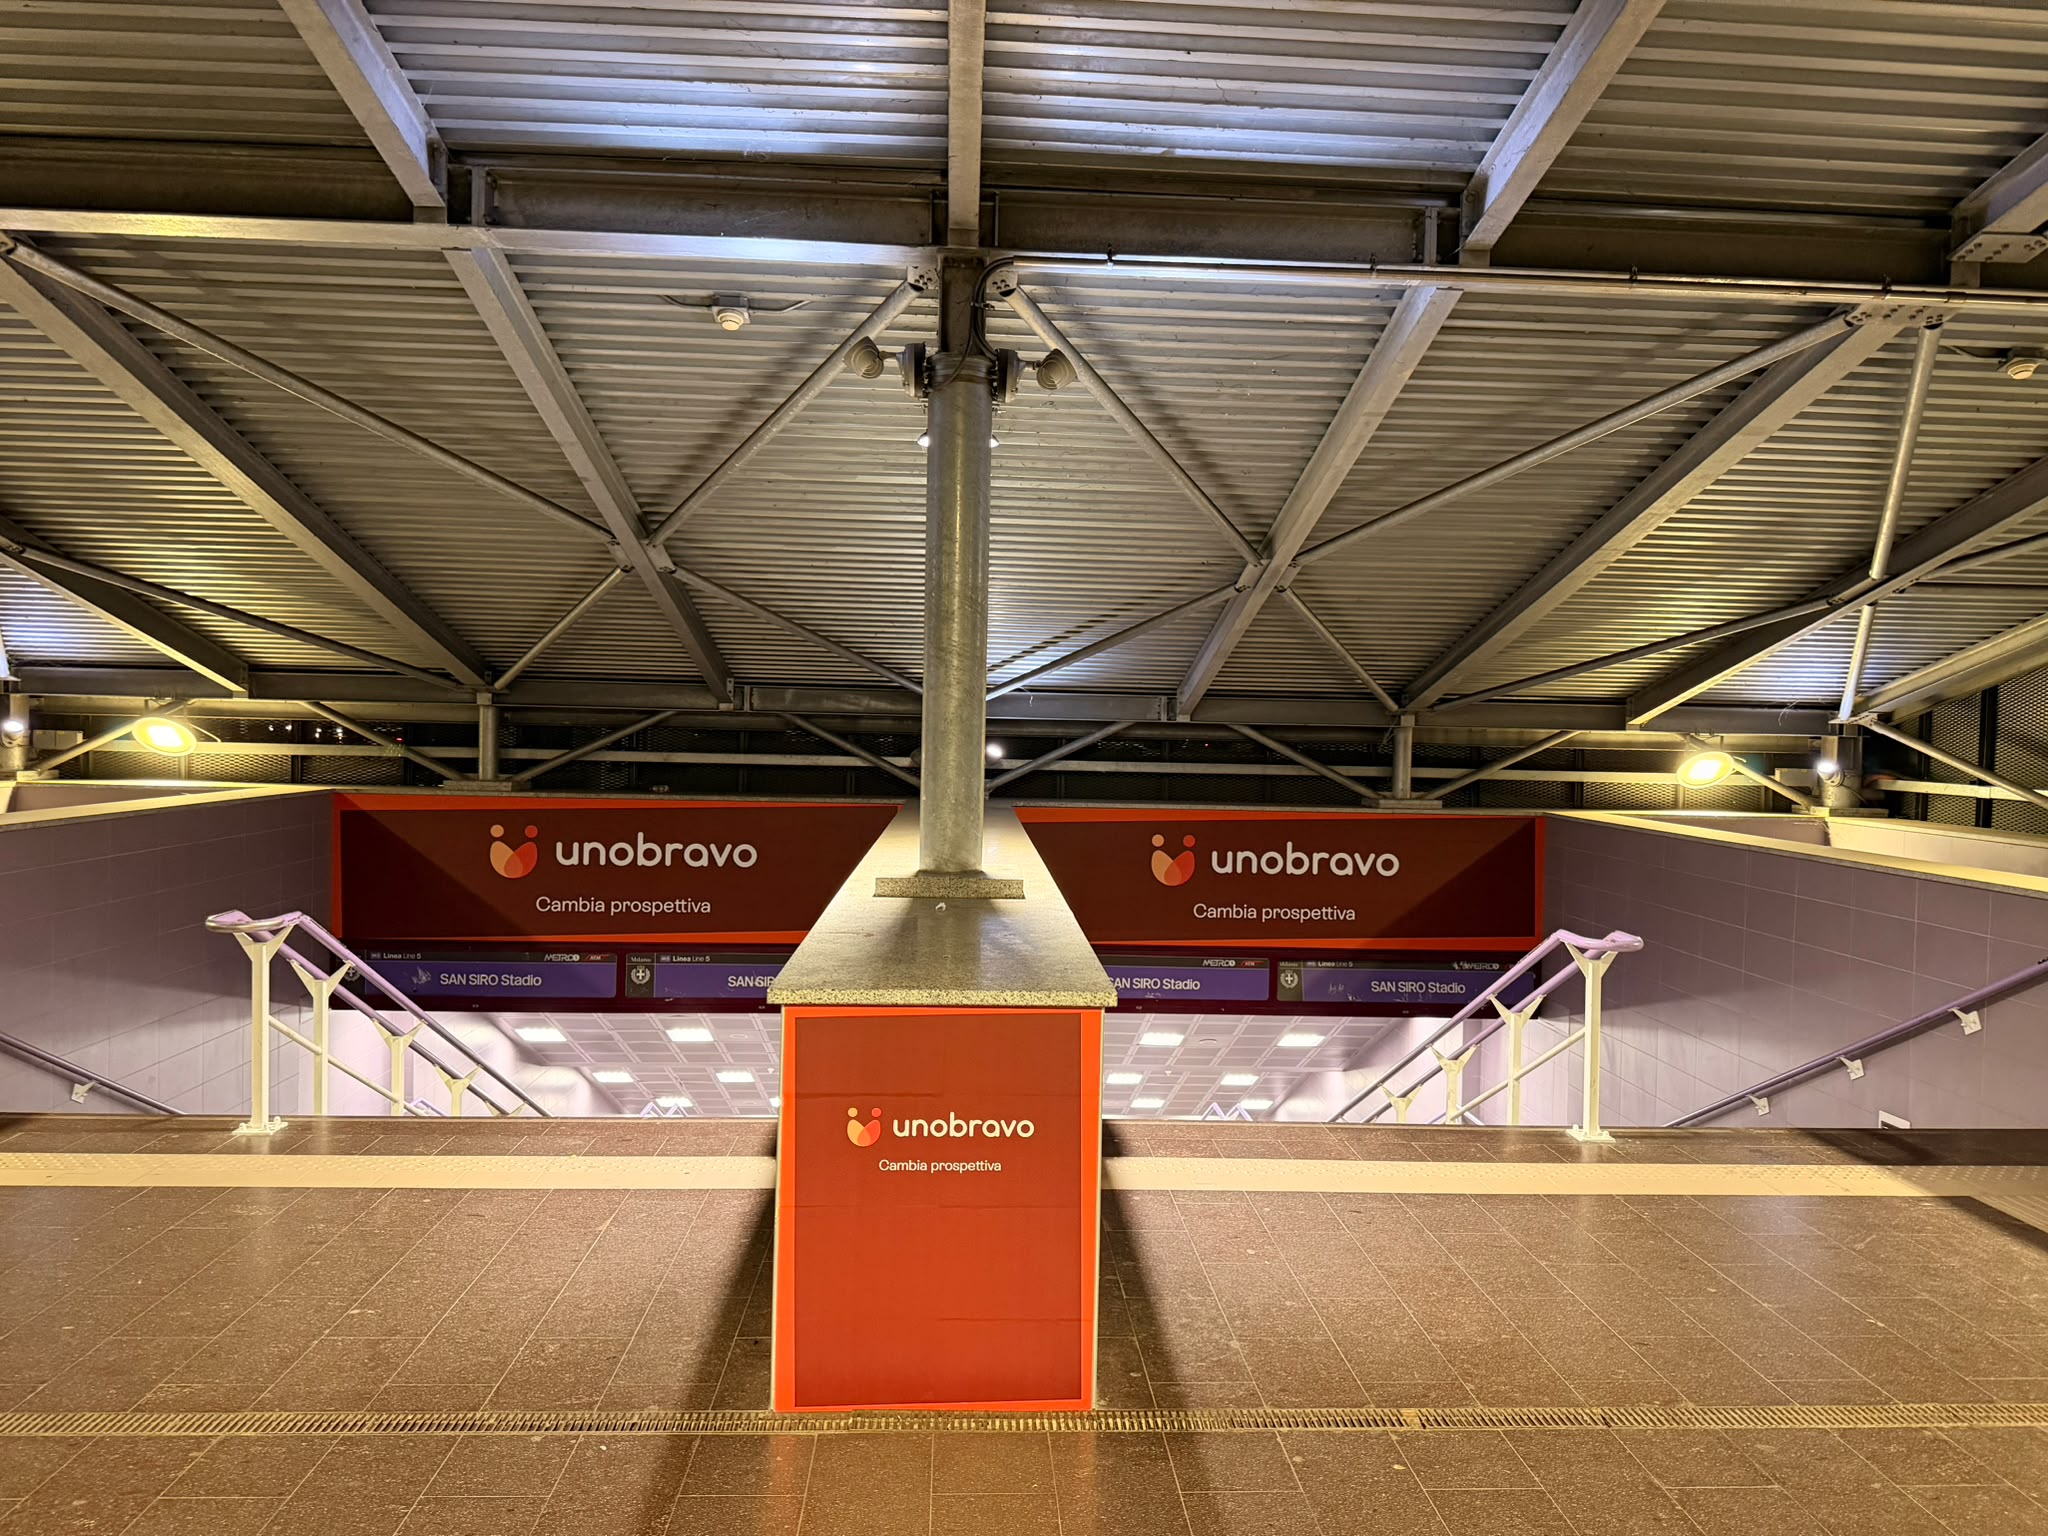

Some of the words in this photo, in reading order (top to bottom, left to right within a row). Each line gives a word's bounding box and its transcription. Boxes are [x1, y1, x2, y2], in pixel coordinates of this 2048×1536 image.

[555, 831, 758, 868] unobravo
[1211, 841, 1400, 877] unobravo
[535, 896, 605, 913] Cambia
[610, 897, 711, 917] prospettiva
[1193, 903, 1257, 919] Cambia
[1262, 905, 1356, 923] prospettiva
[440, 973, 467, 985] SAN
[468, 973, 499, 986] SIRO
[500, 974, 542, 986] Stadio
[727, 975, 754, 987] SAN
[1132, 977, 1161, 990] SIRO
[1162, 978, 1201, 991] Stadio
[1370, 980, 1396, 992] SAN
[1397, 981, 1426, 993] SIRO
[1427, 982, 1466, 994] Stadio
[892, 1111, 1035, 1138] unobravo
[878, 1159, 928, 1172] Cambia
[930, 1159, 1002, 1174] prospettiva
